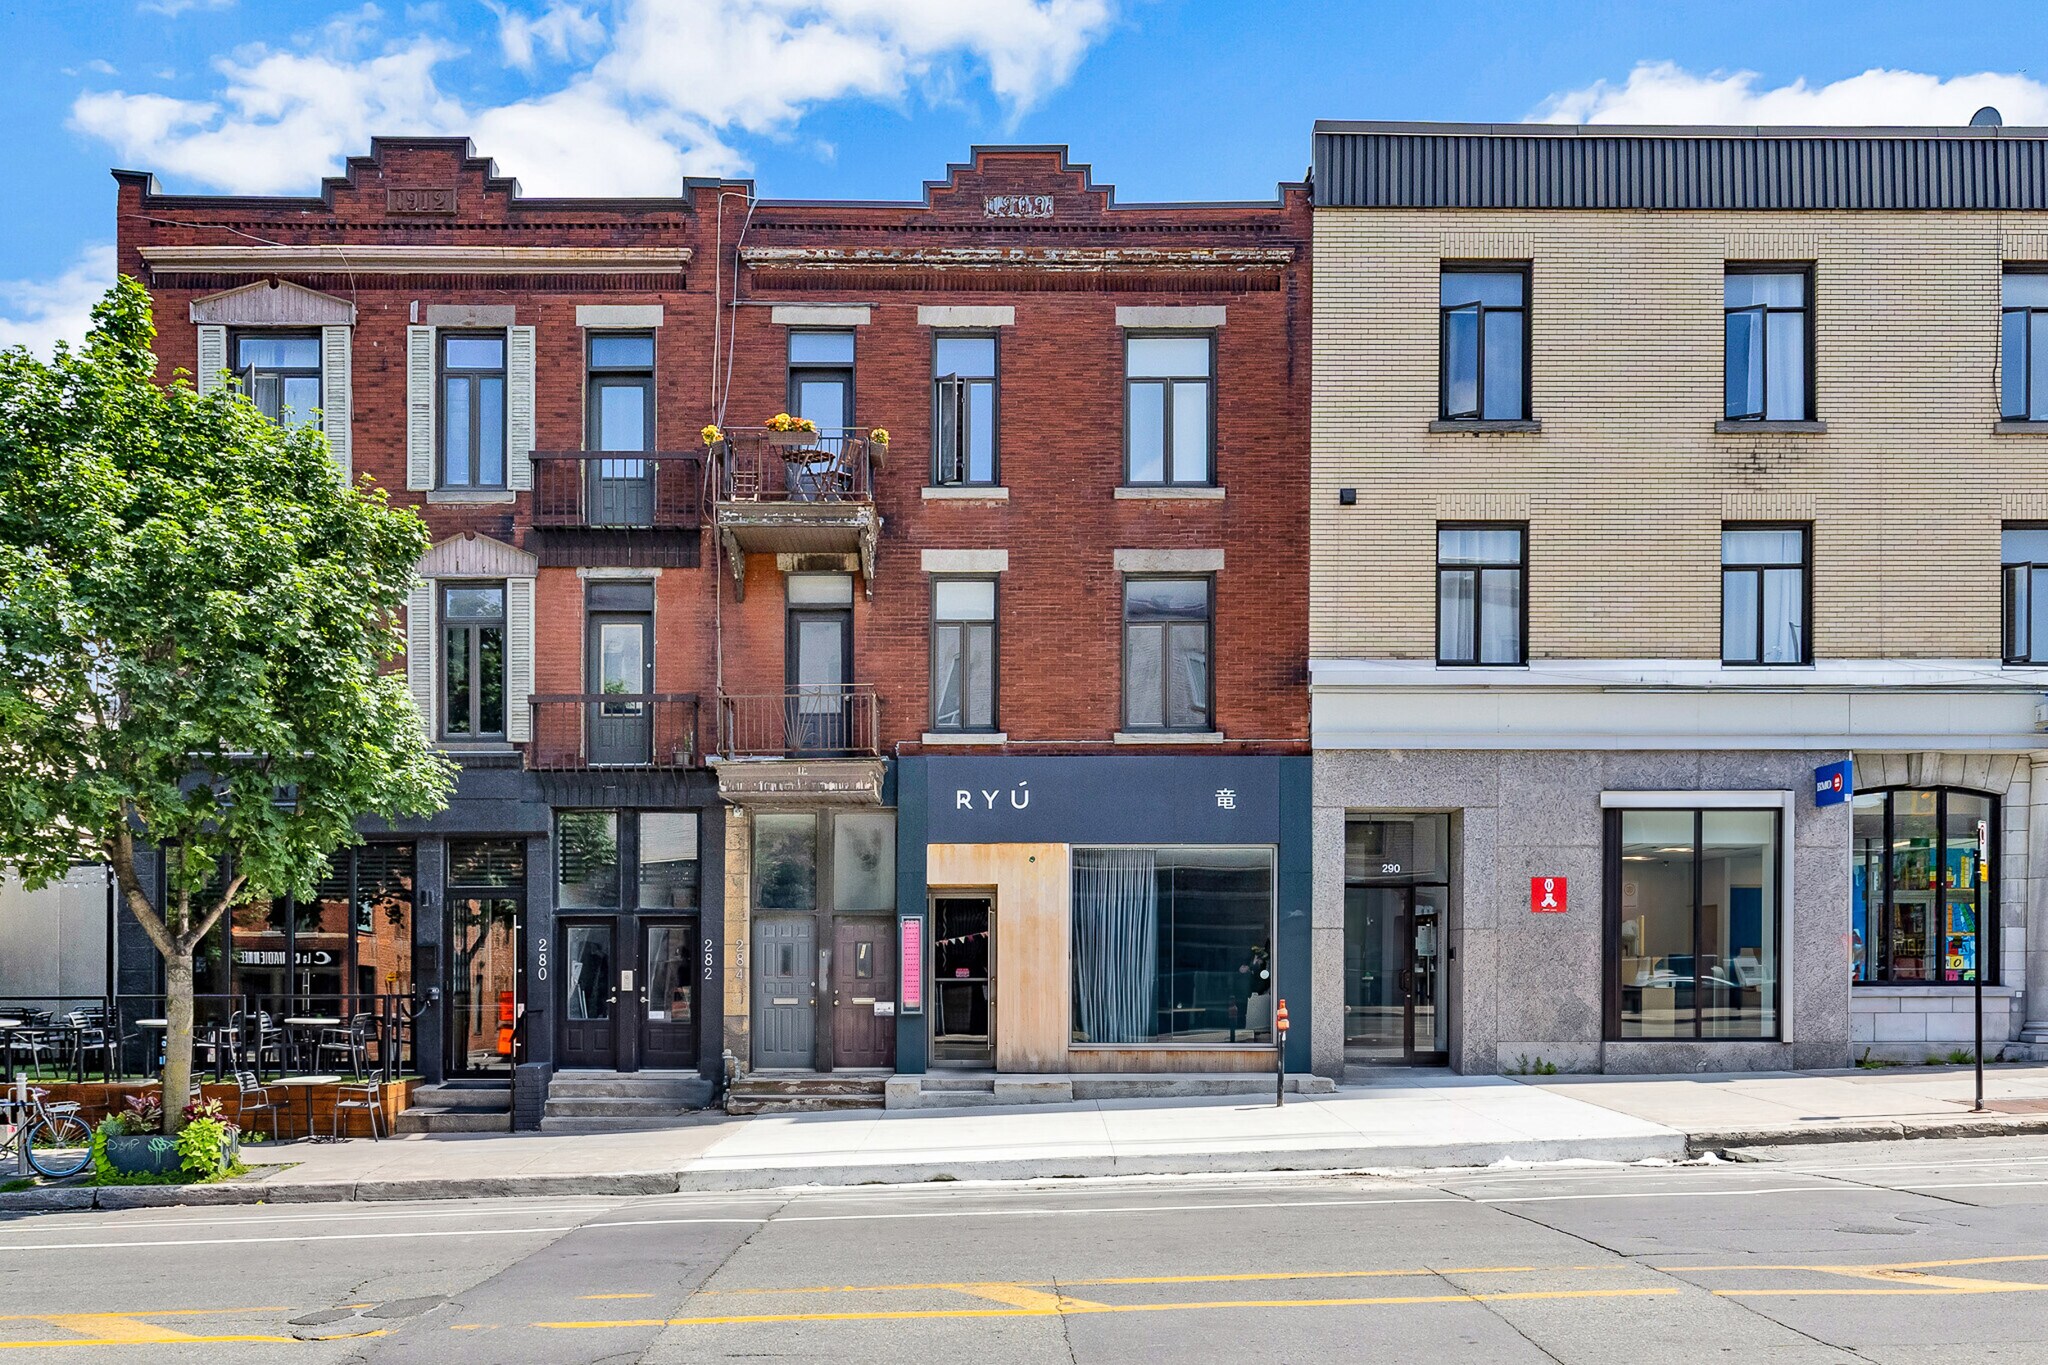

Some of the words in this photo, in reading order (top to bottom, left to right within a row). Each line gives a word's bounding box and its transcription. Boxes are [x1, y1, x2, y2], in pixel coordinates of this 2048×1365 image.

[396, 191, 445, 210] 1912
[956, 780, 1029, 810] RYÚ
[1215, 787, 1237, 810] 竜
[1816, 779, 1832, 792] BMO
[1381, 864, 1401, 874] 290
[538, 938, 548, 981] 280
[704, 938, 713, 980] 282
[735, 939, 744, 980] 284
